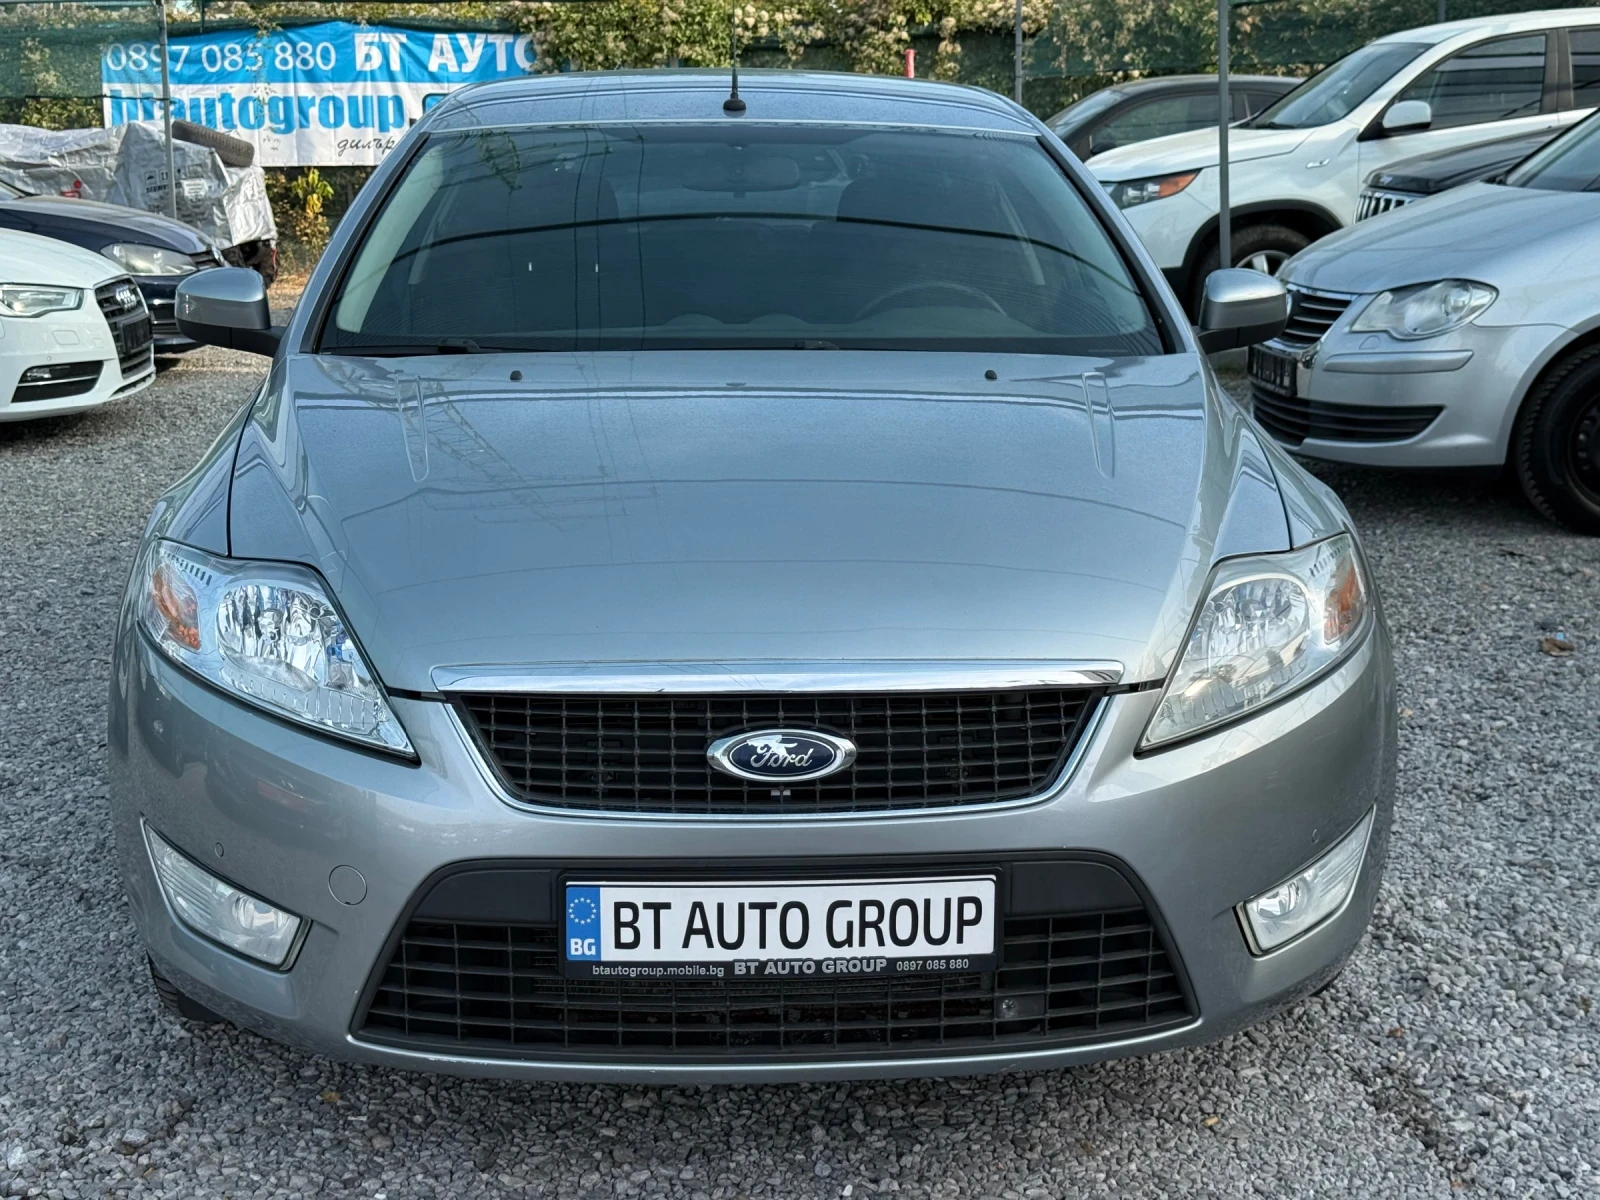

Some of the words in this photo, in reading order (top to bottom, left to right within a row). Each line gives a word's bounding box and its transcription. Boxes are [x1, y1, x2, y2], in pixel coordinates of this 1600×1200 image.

[201, 43, 263, 72] 085
[274, 41, 336, 71] 880
[354, 33, 407, 72] БТ
[750, 742, 815, 768] Ford
[613, 900, 672, 950] BT
[682, 900, 810, 950] AUTO
[825, 895, 983, 949] GROUP
[570, 938, 597, 957] BG
[592, 965, 725, 977] btautogroup.mobile.bg
[733, 961, 759, 975] BT
[764, 961, 816, 975] AUTO
[821, 958, 888, 974] GROUP
[896, 960, 923, 972] 0897
[926, 959, 947, 971] 085
[949, 958, 970, 970] 880
